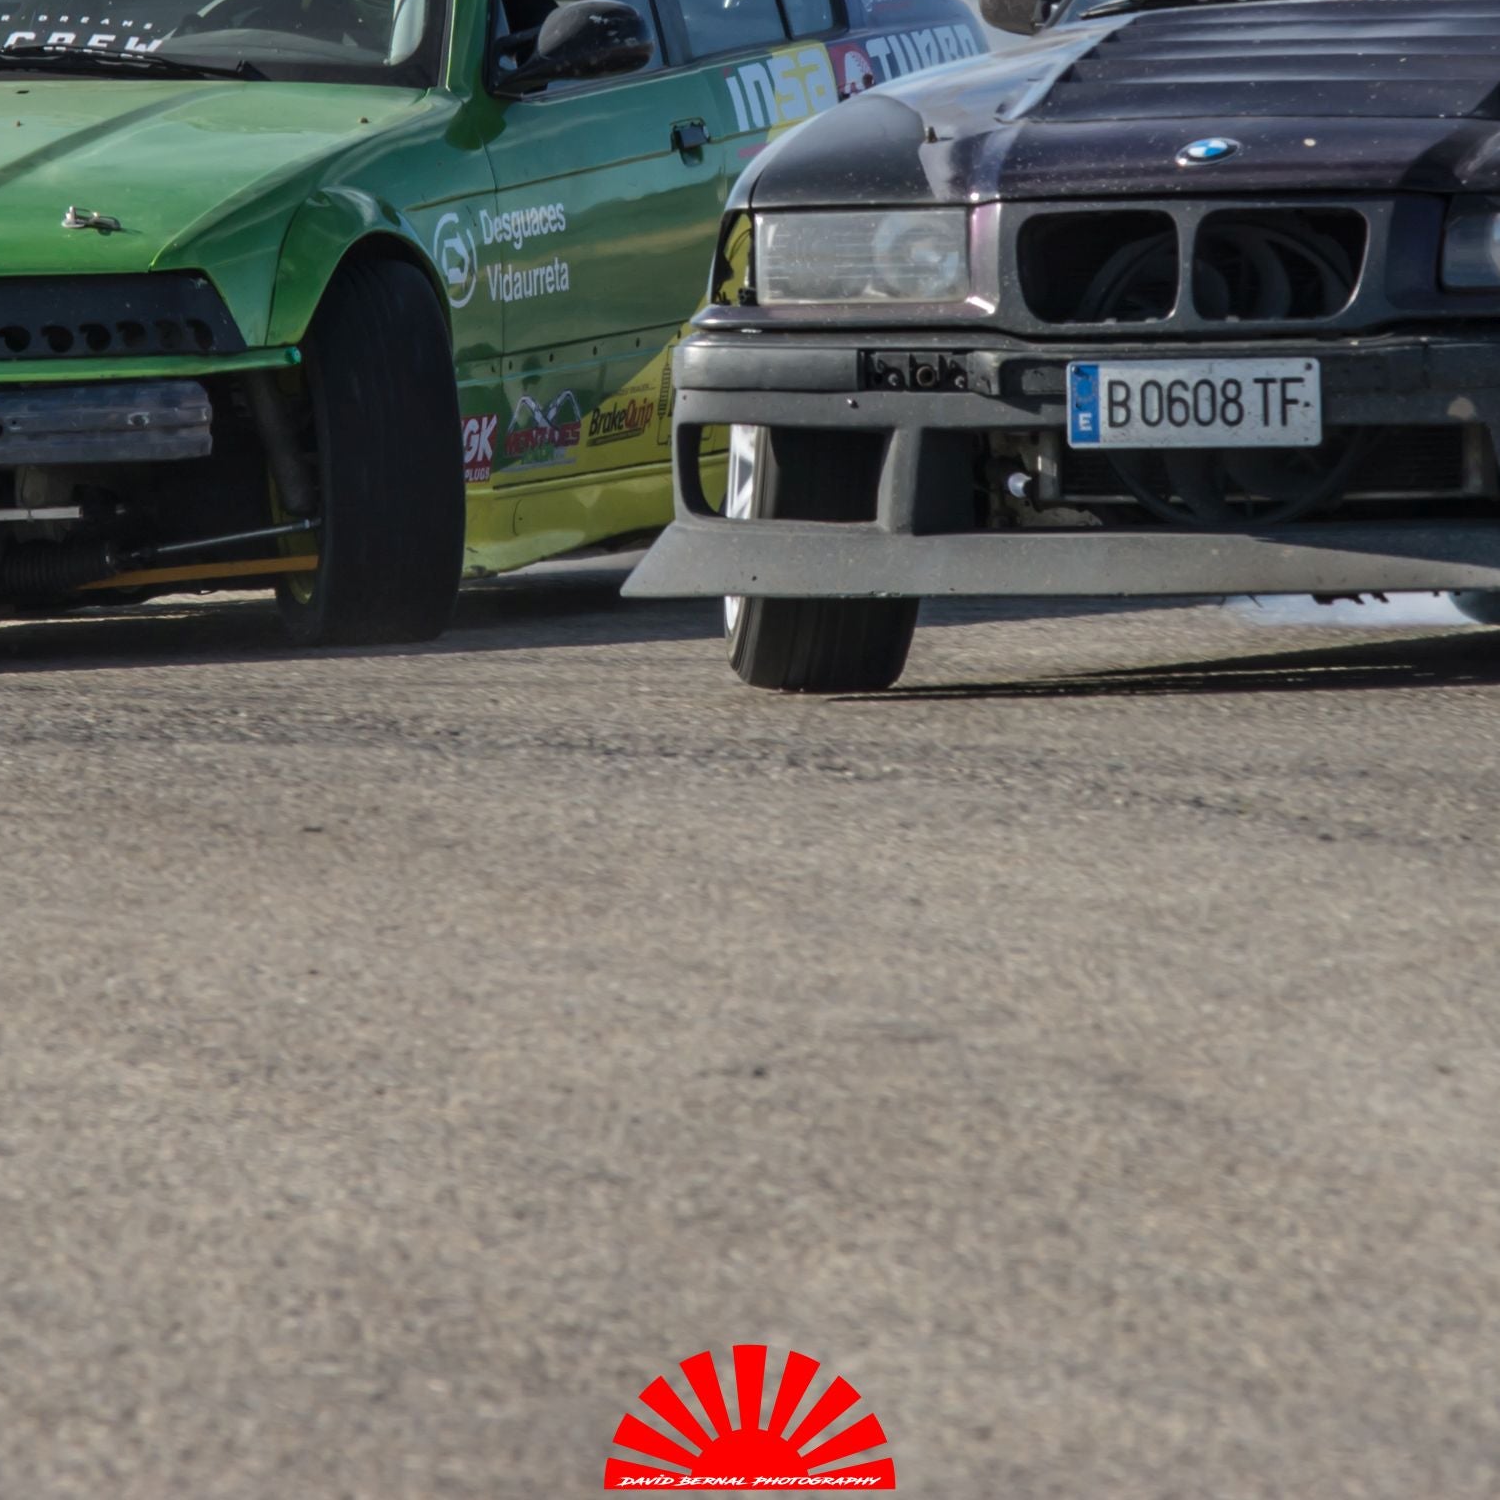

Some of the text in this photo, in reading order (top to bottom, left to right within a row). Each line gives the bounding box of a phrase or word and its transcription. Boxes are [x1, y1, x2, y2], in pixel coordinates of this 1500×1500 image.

[478, 202, 567, 250] Desguaces
[486, 256, 570, 303] Vidaurreta
[461, 414, 498, 463] GK
[588, 397, 654, 436] BrakeQuip
[1078, 412, 1093, 432] E
